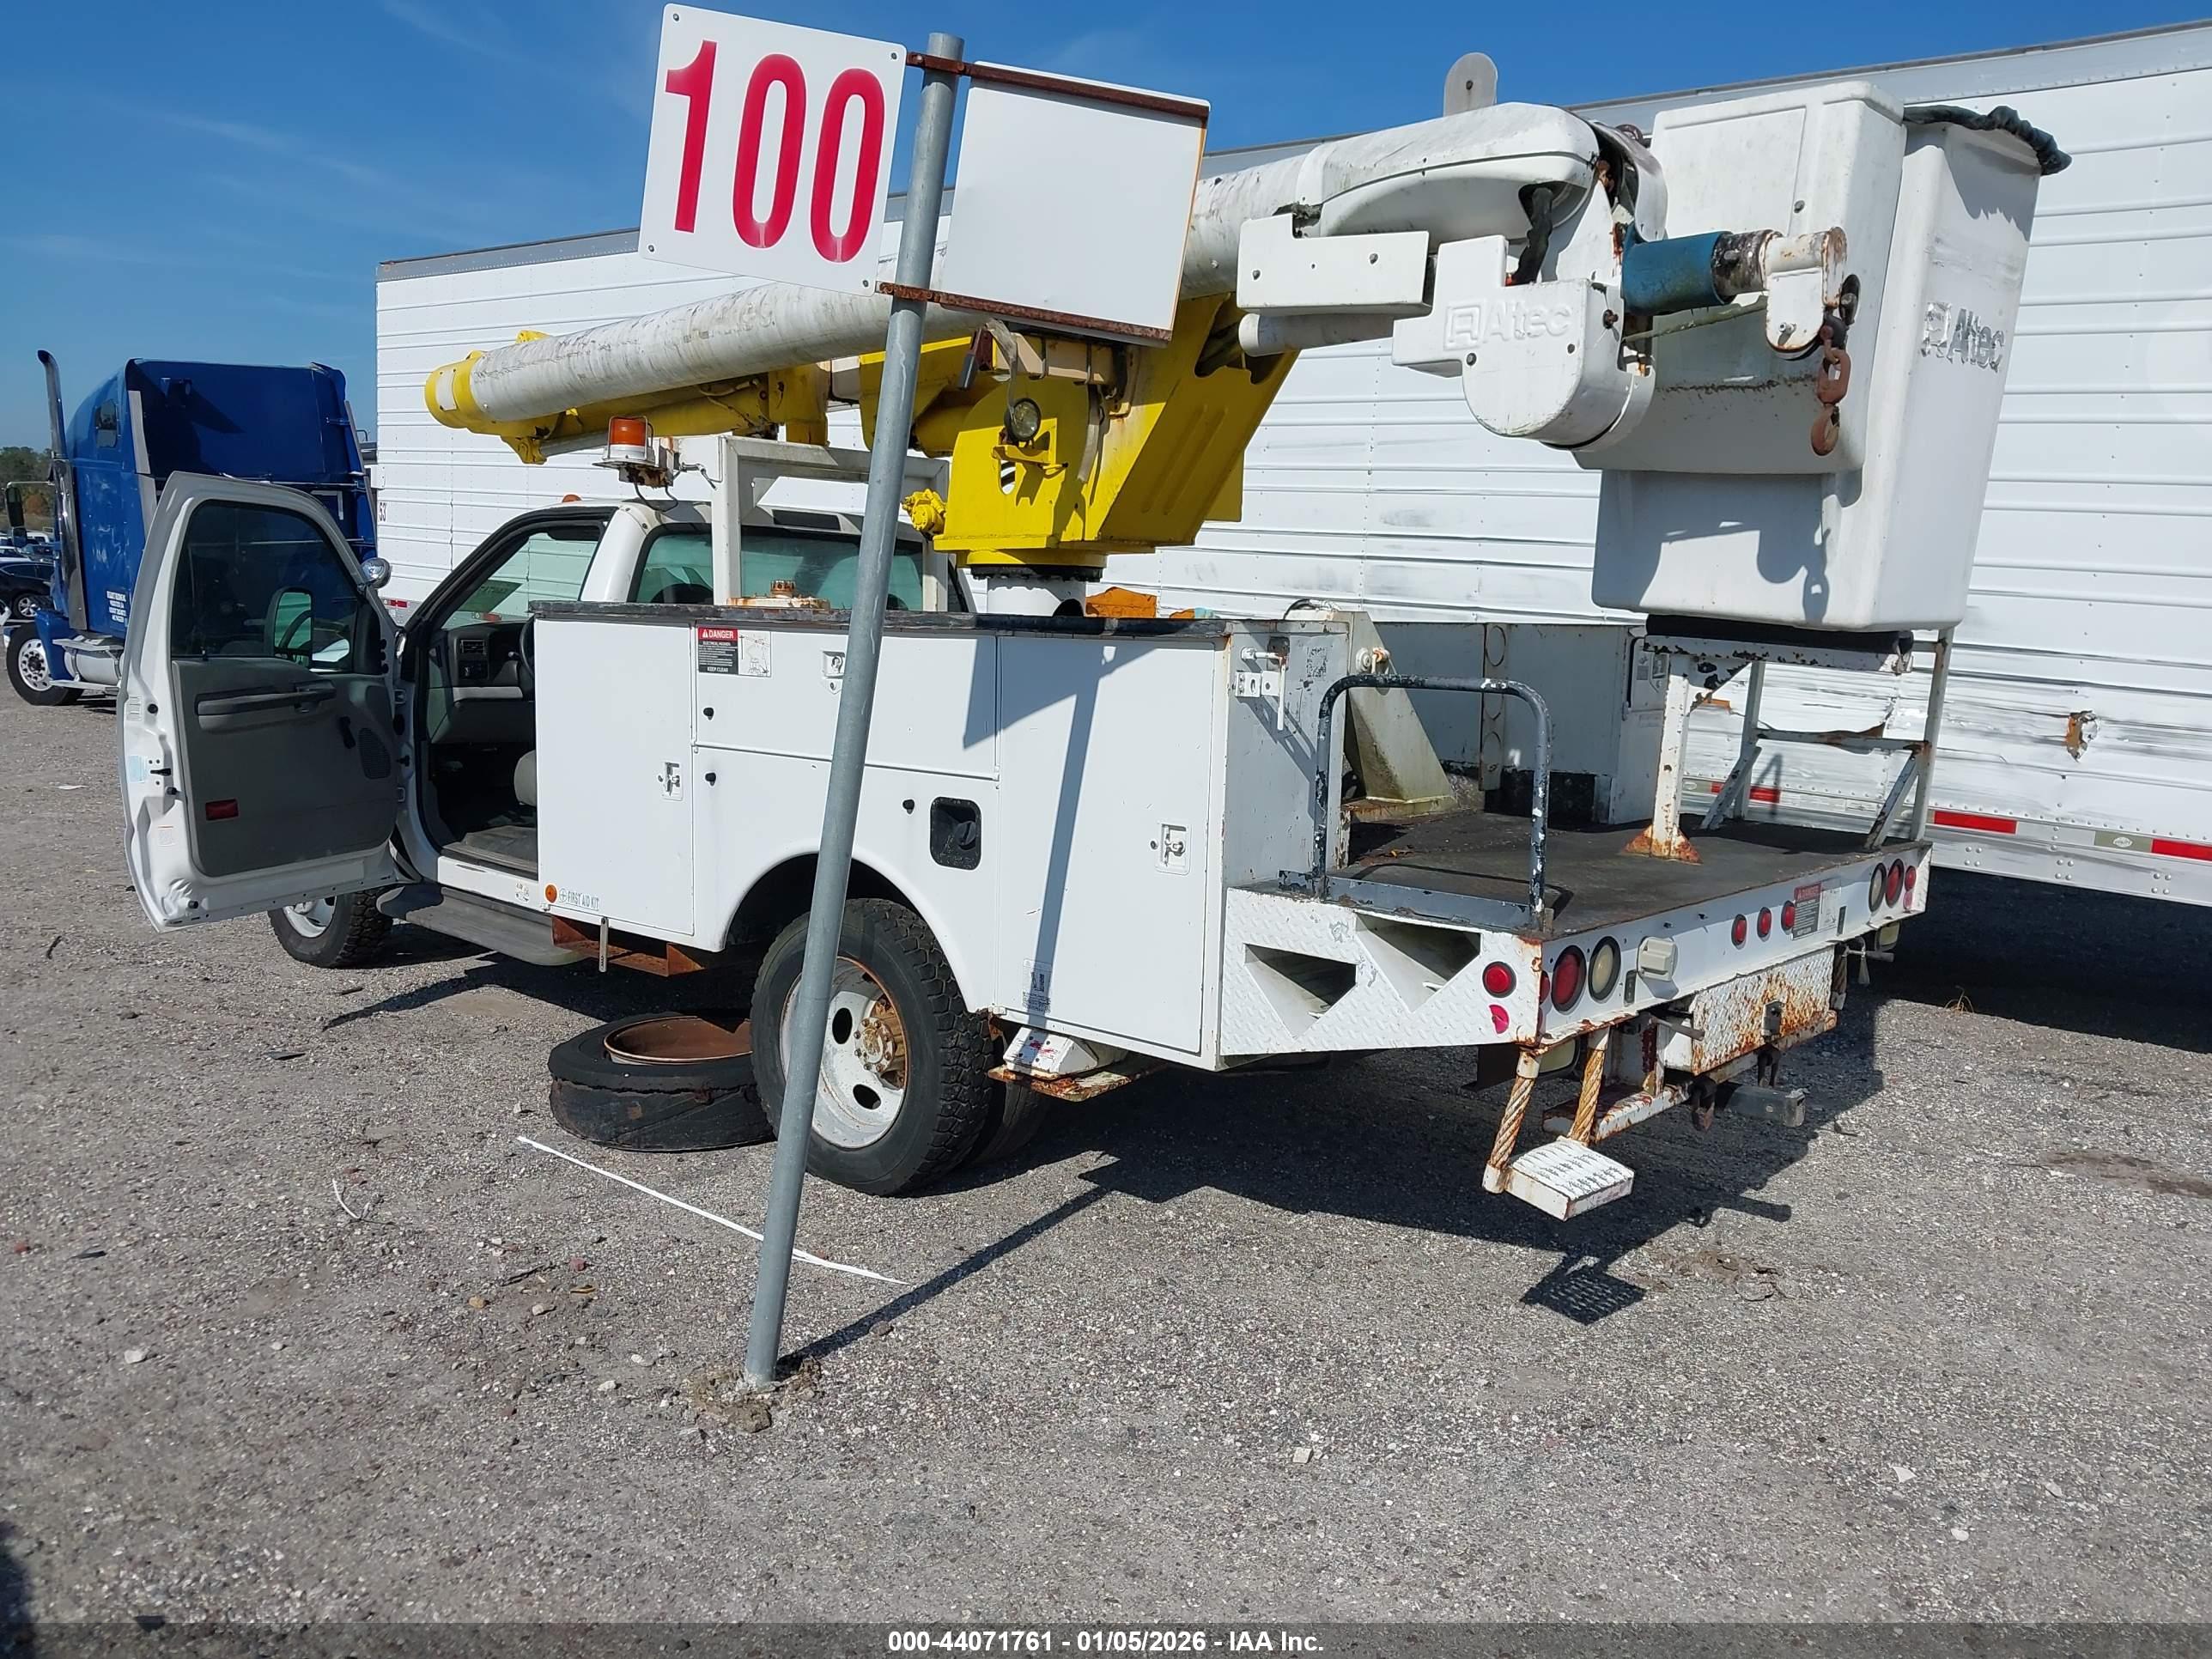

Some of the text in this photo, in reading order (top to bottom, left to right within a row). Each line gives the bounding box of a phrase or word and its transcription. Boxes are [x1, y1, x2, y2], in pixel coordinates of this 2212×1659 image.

[665, 40, 884, 264] 100
[1484, 299, 1573, 343] Altec
[1946, 308, 2005, 373] Altec
[708, 629, 733, 639] DANGER
[568, 890, 599, 910] FIRST AID KIT
